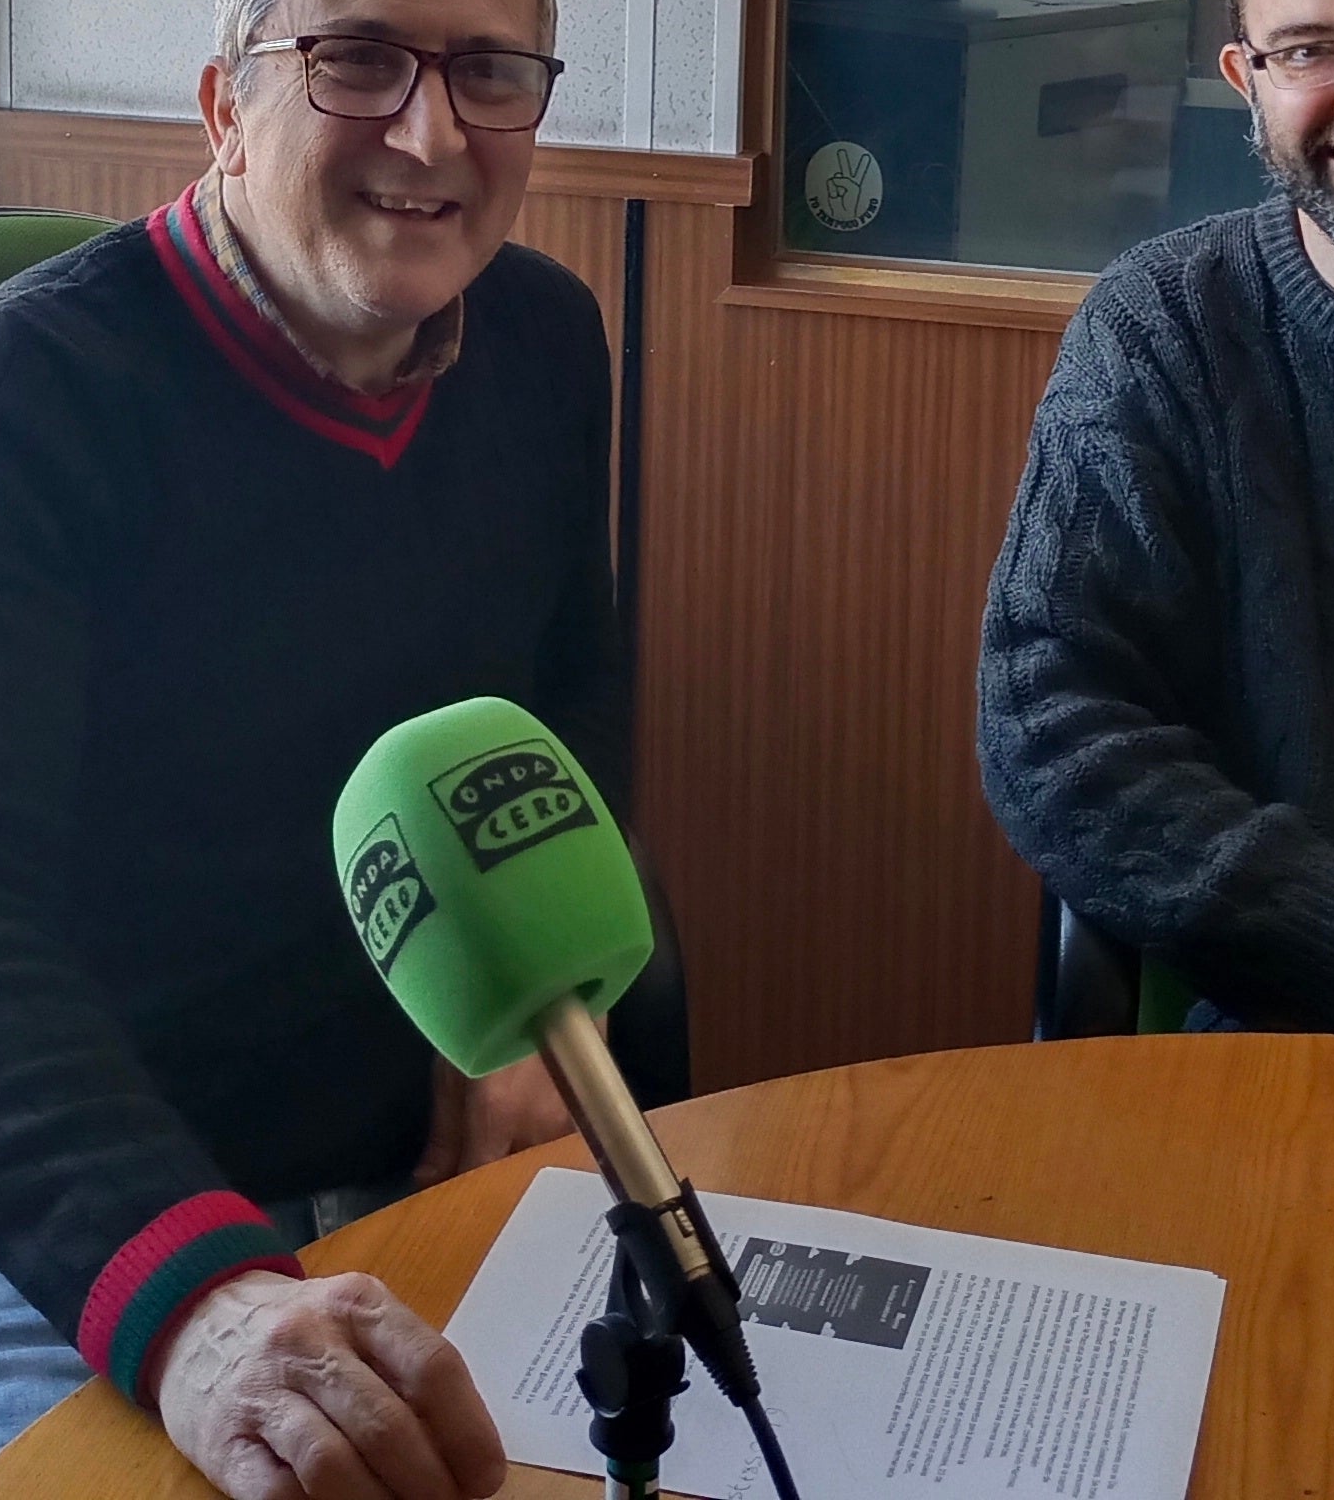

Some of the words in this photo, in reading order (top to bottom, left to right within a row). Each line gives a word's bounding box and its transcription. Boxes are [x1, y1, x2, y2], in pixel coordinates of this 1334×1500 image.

[460, 760, 550, 804] ONDA
[489, 792, 571, 839] CERO
[352, 850, 394, 914] ONDA
[370, 884, 410, 950] CERO
